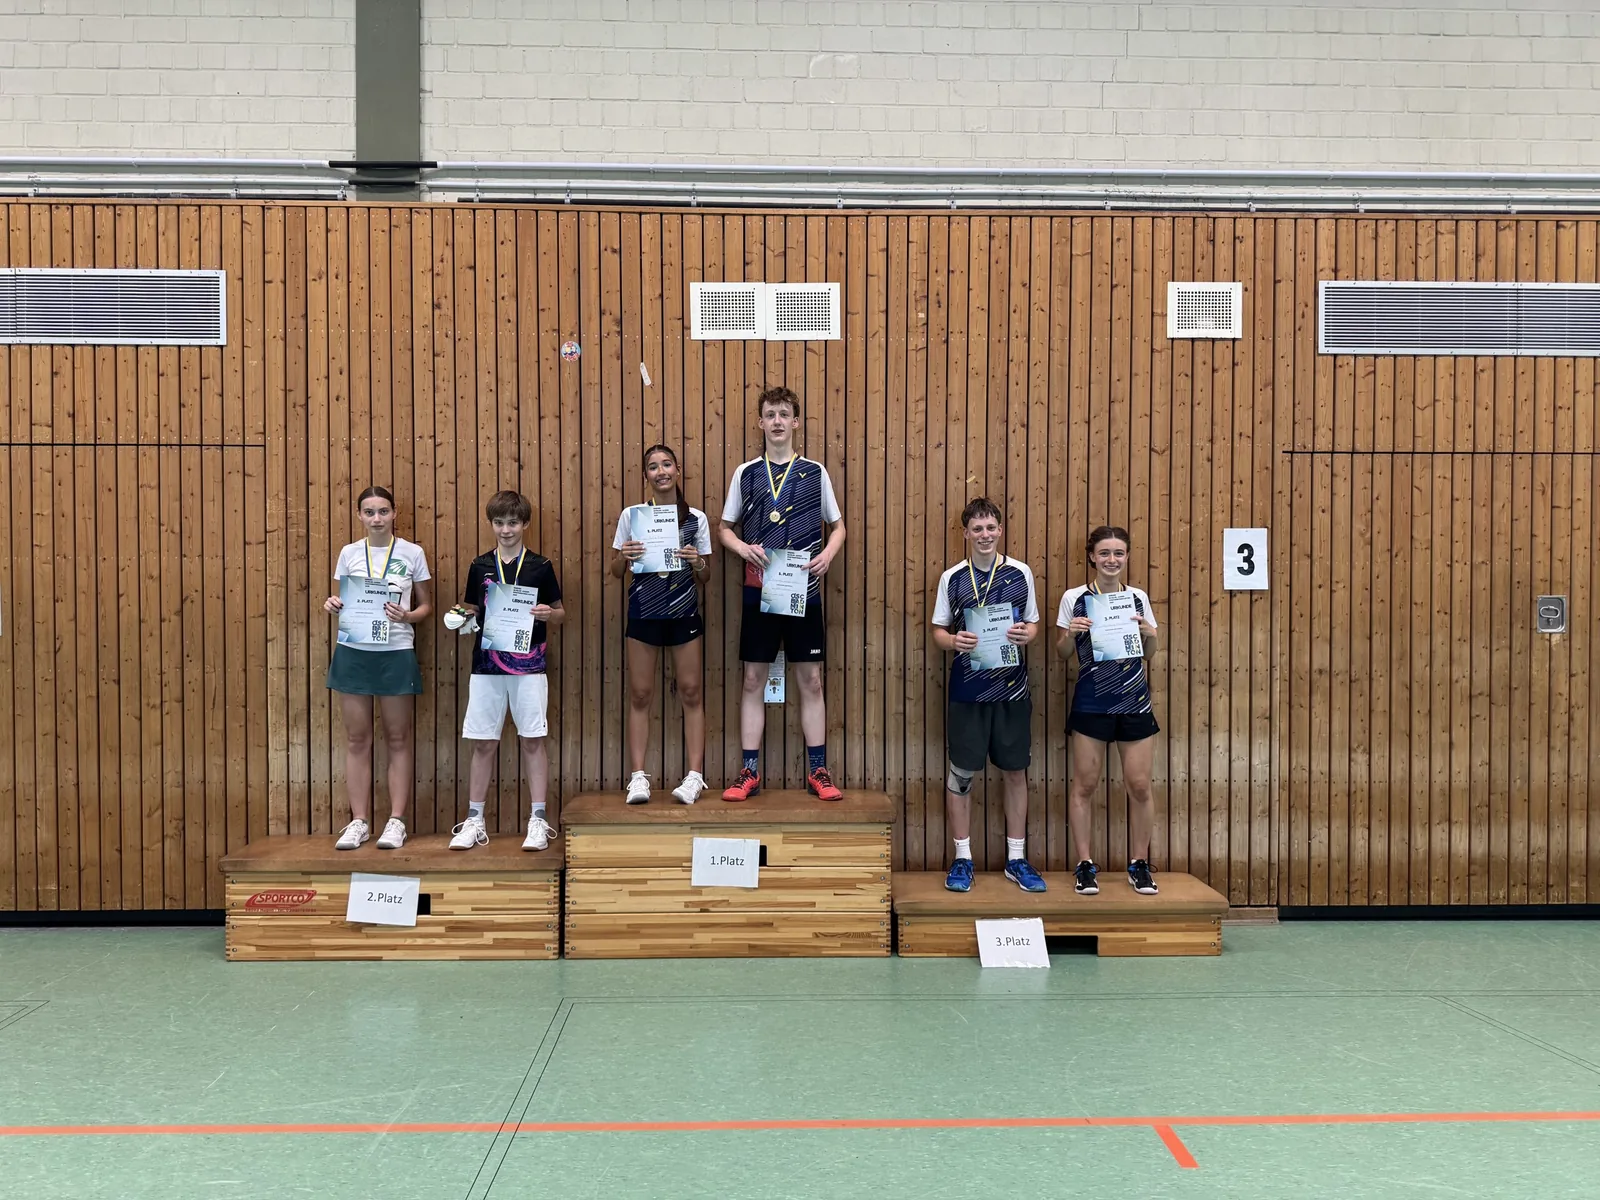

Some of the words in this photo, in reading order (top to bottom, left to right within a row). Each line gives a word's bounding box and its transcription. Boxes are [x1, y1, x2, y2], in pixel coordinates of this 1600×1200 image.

[1236, 543, 1255, 576] 3
[710, 856, 745, 866] 1.Platz
[256, 894, 305, 904] SPORTCO
[367, 892, 403, 904] 2.Platz
[996, 936, 1030, 946] 3.Platz
